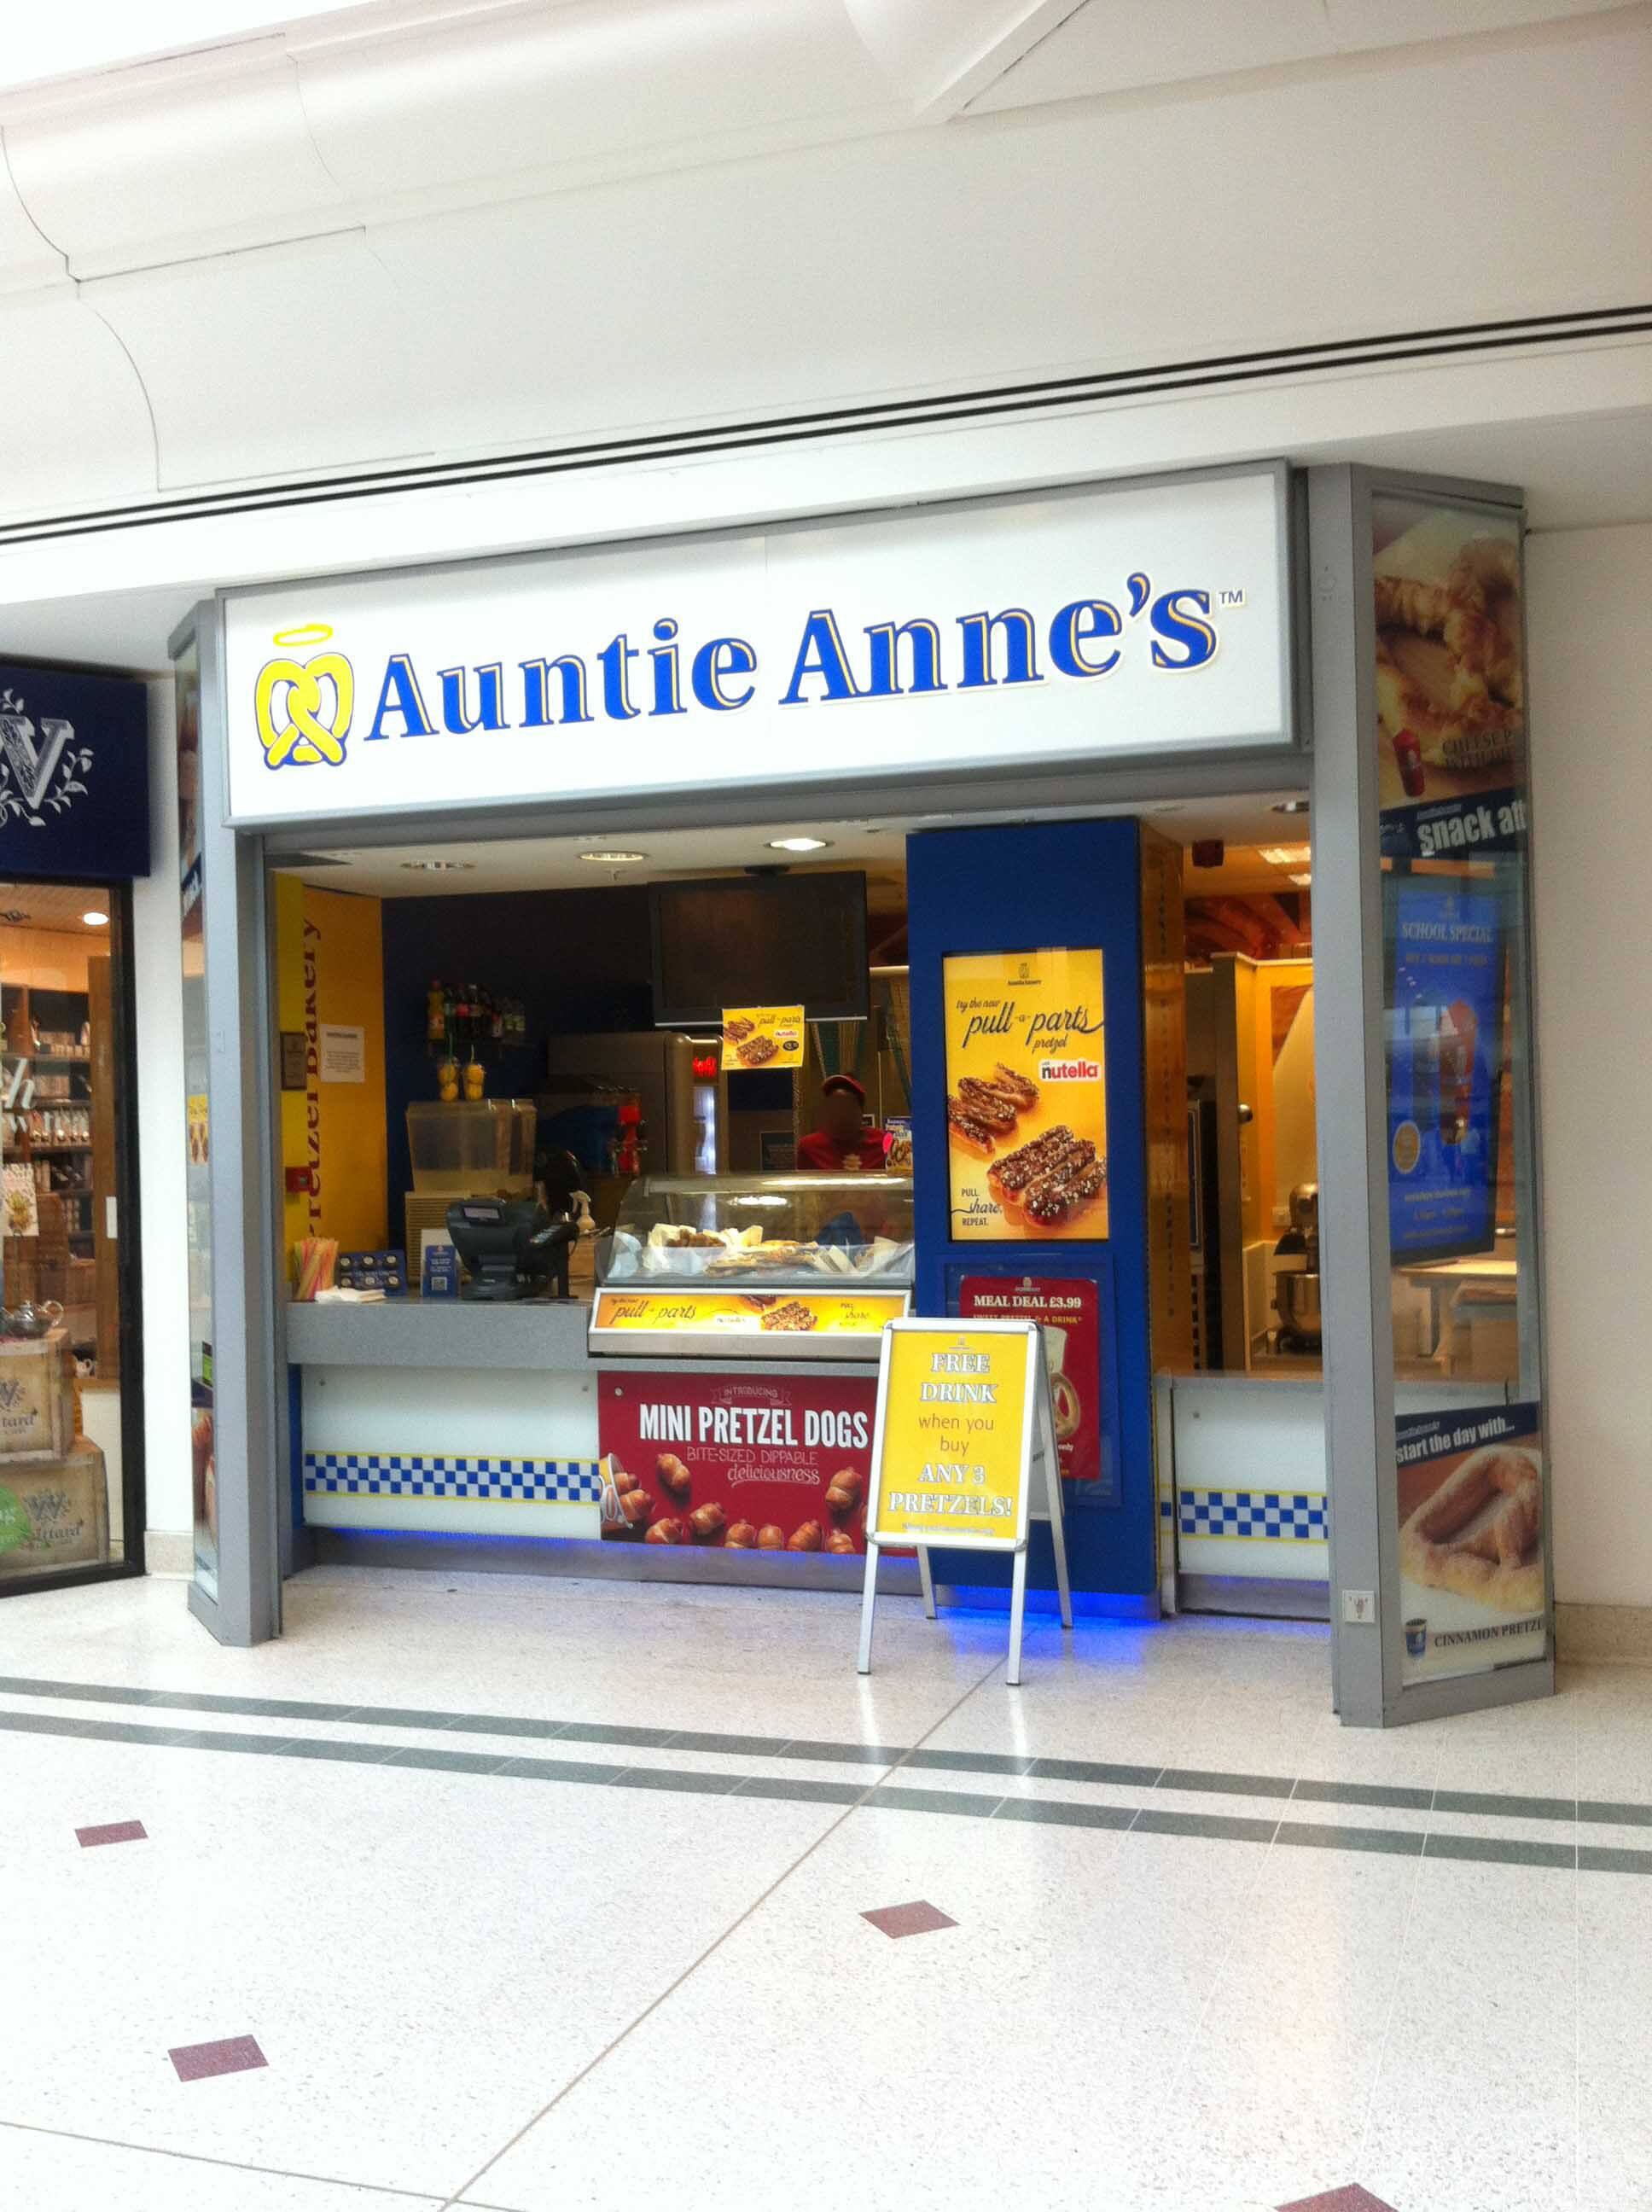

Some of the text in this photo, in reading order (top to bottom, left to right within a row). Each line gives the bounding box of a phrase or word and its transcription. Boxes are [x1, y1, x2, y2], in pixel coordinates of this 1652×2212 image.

[364, 618, 758, 742] Auntie
[778, 573, 1217, 705] Anne's
[1417, 806, 1496, 853] snack
[1402, 922, 1495, 943] SCHOOL SPECIAL
[1032, 1034, 1068, 1055] pretzel
[1041, 1062, 1099, 1080] nutella
[307, 1092, 322, 1237] retzel
[974, 1295, 1010, 1307] MEAL
[1012, 1295, 1047, 1308] DEAL
[930, 1353, 991, 1373] FREE
[919, 1382, 999, 1404] DRINK
[639, 1403, 870, 1450] MINI PRETZEL DOGS
[918, 1413, 995, 1433] when you
[939, 1436, 970, 1458] buy
[1397, 1438, 1429, 1463] start
[1429, 1432, 1451, 1453] the
[1452, 1427, 1477, 1448] day
[686, 1447, 820, 1466] BITE-SIZED DIPPABLE
[727, 1463, 821, 1486] deliciousness
[917, 1463, 986, 1485] ANY 3
[887, 1491, 1014, 1516] PRETZELS!
[1434, 1626, 1498, 1648] CINNAMON
